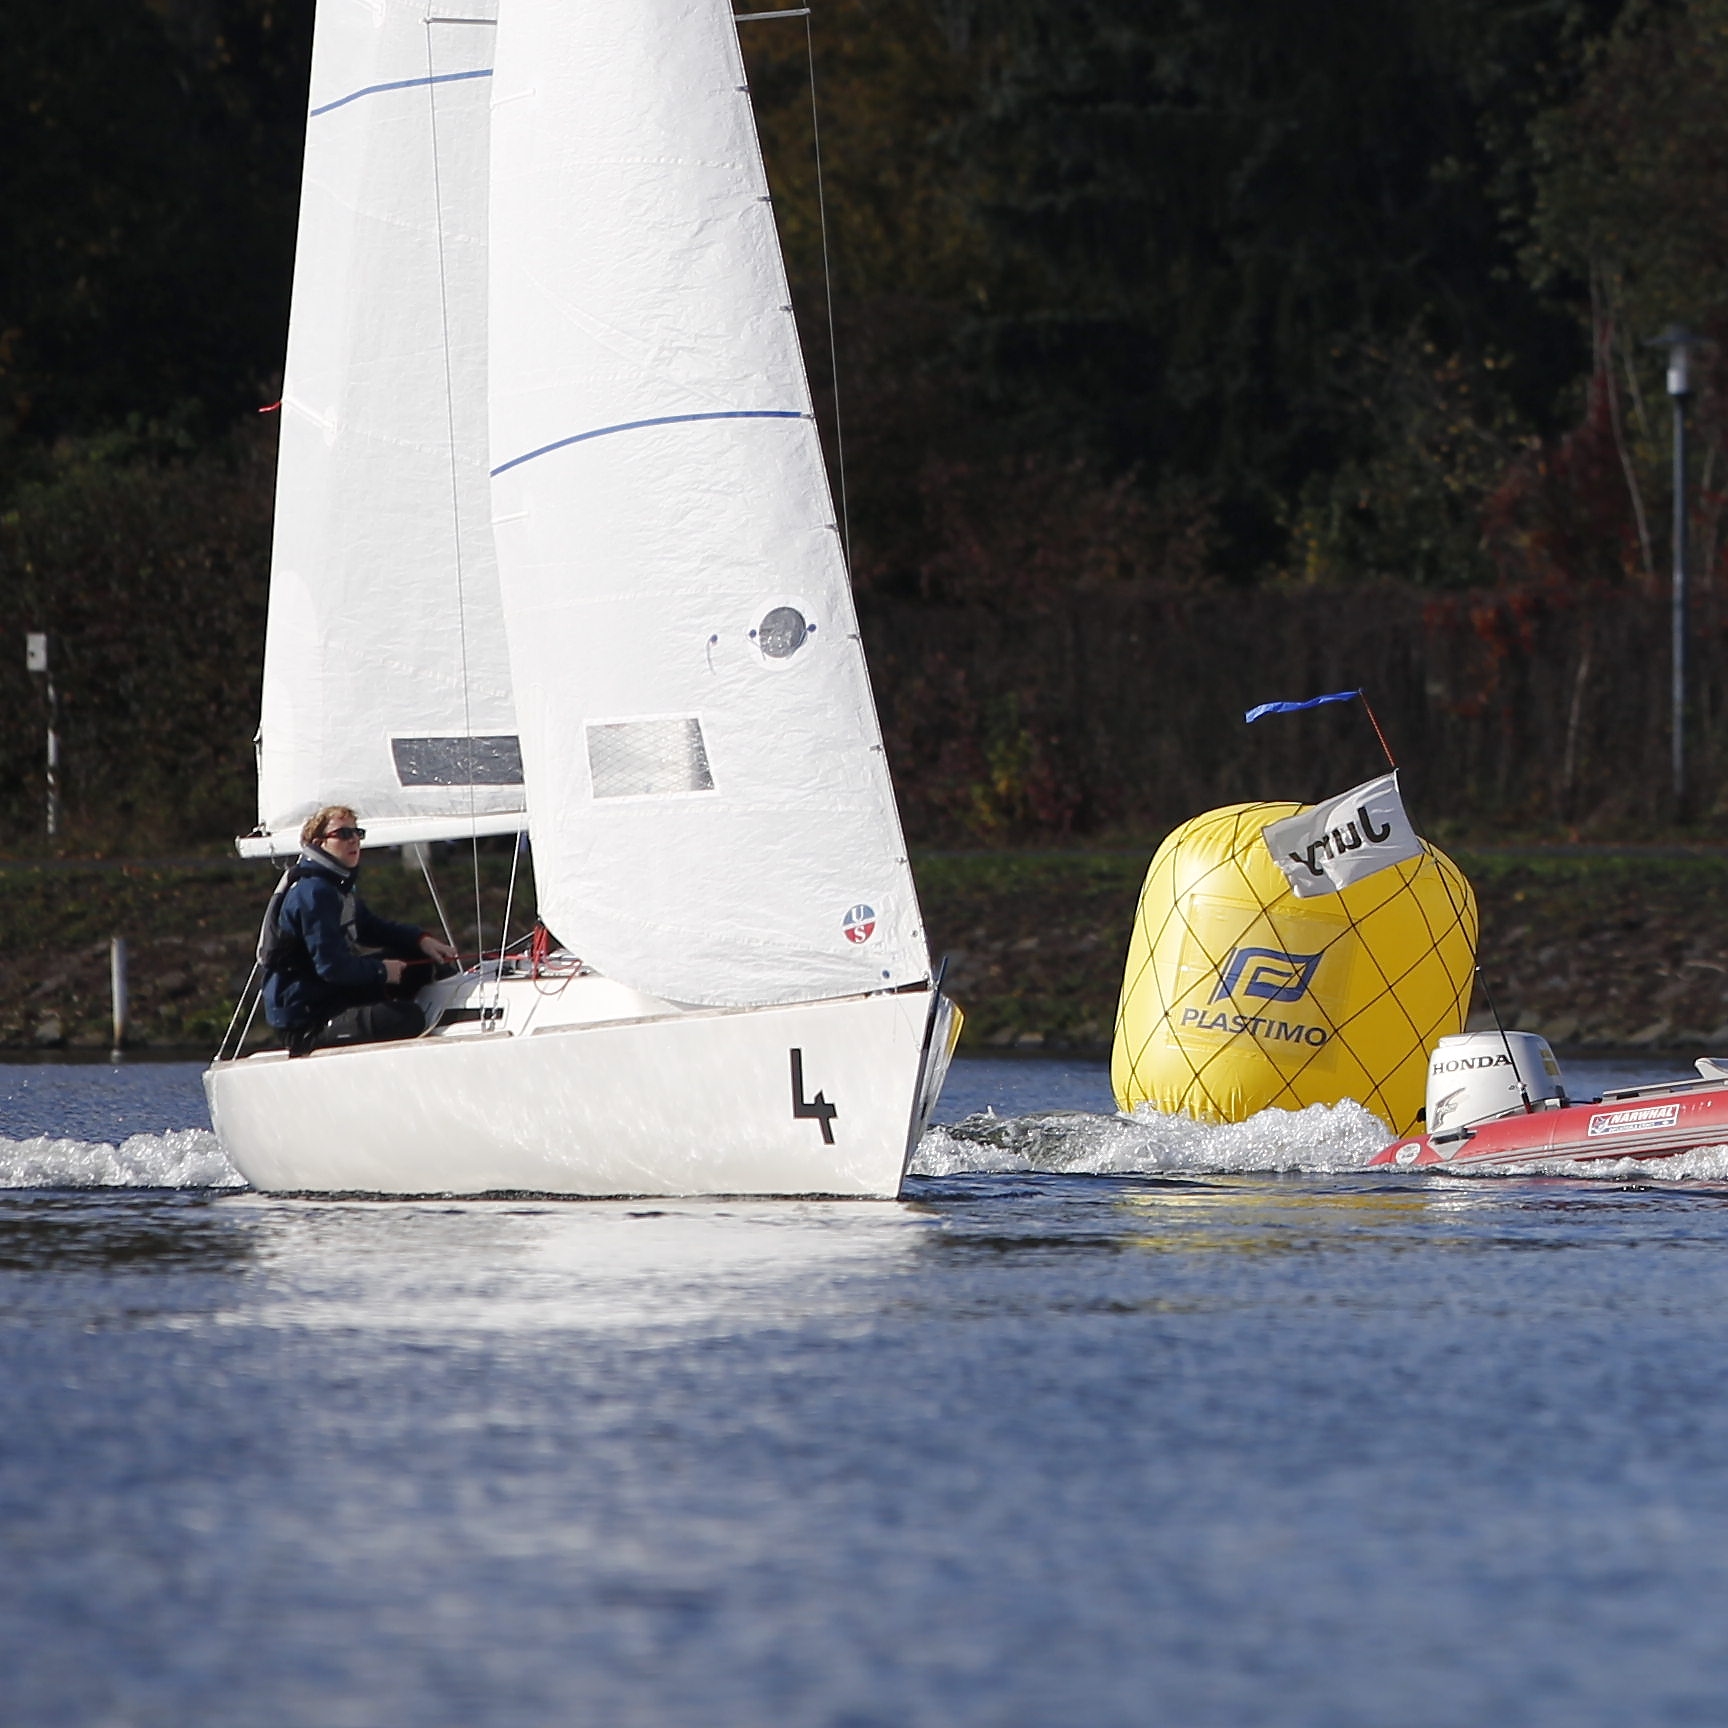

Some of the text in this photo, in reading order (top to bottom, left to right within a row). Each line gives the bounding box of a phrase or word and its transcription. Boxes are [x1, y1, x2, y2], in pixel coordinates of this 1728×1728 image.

[1180, 1007, 1328, 1046] PLASTIMO
[1433, 1054, 1513, 1075] HONDA
[790, 1048, 837, 1145] 4
[1611, 1106, 1674, 1124] NARWHAL
